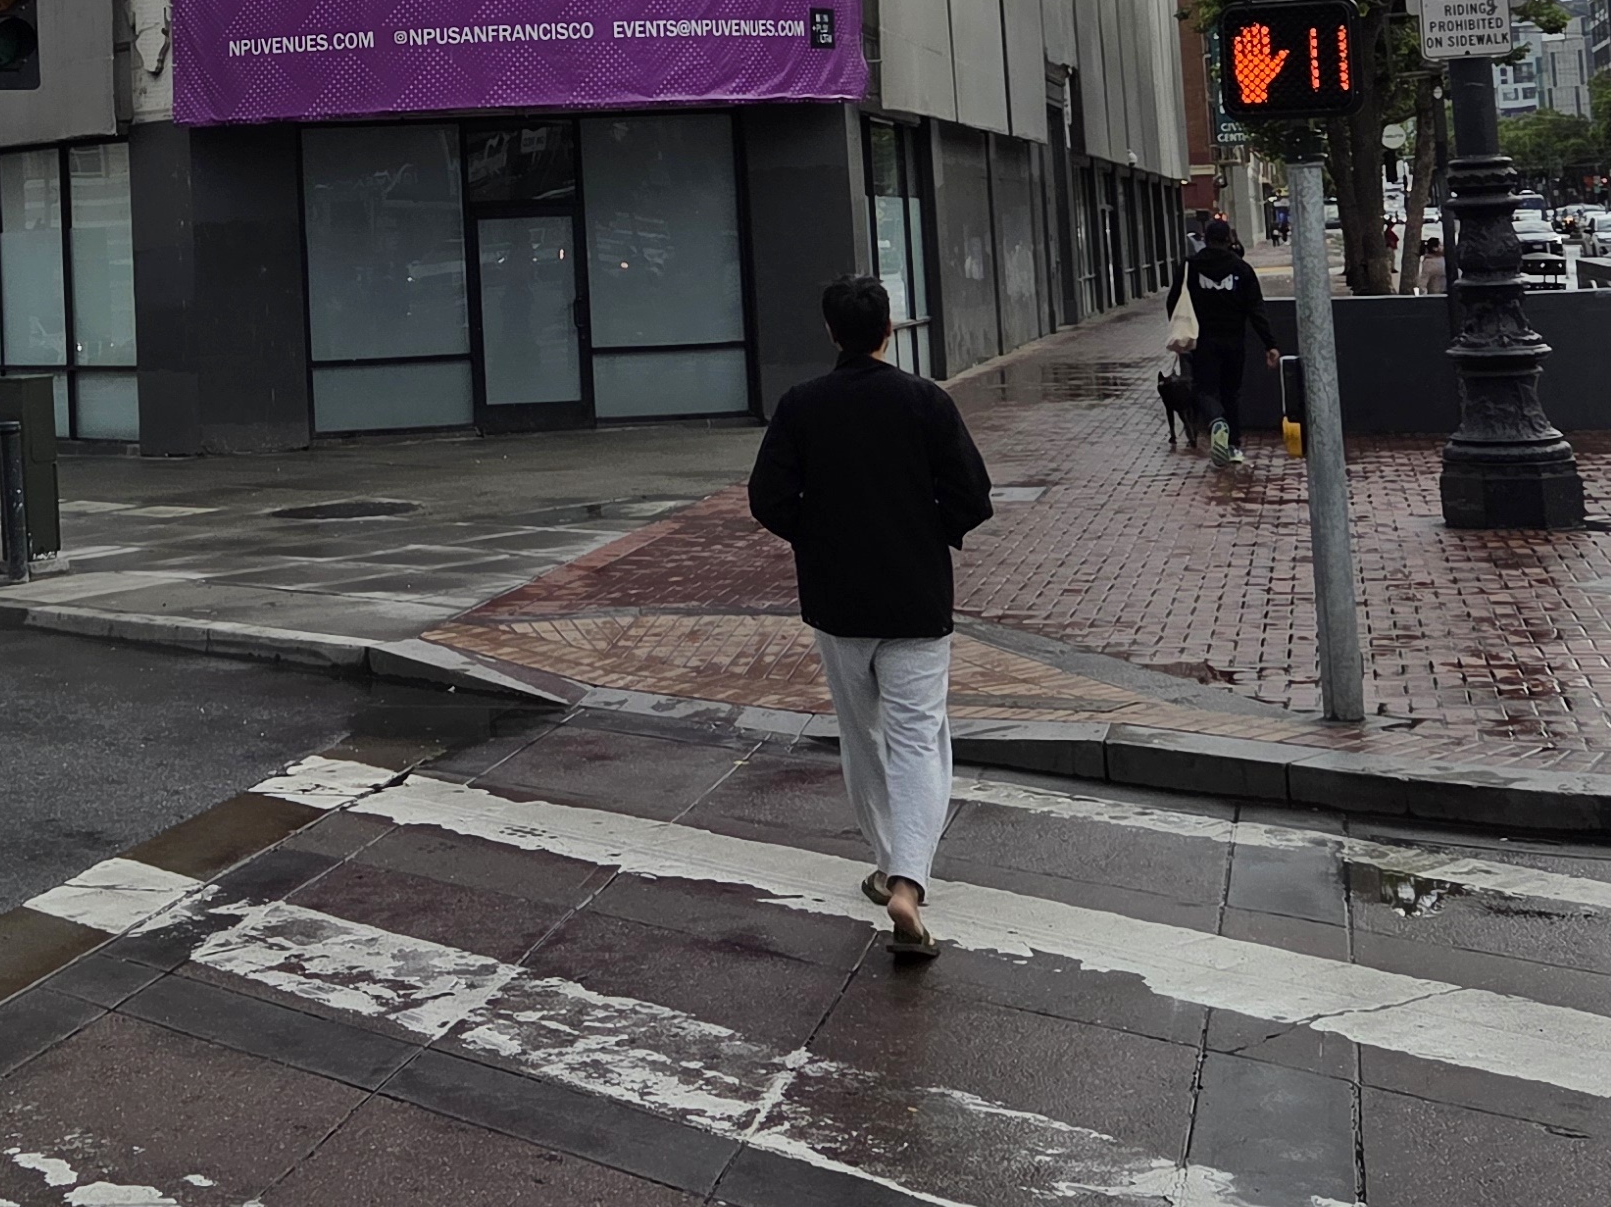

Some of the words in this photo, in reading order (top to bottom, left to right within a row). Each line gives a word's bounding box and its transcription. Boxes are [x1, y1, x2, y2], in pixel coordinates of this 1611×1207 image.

[1444, 2, 1487, 16] RIDING
[612, 19, 805, 39] EVENTS@NPUVENUES.COM
[1429, 16, 1504, 33] PROHIBITED
[228, 30, 375, 58] NPUVENUES.COM
[1426, 36, 1443, 49] ON
[1447, 32, 1509, 48] SIDEWALK
[1309, 24, 1350, 92] 11
